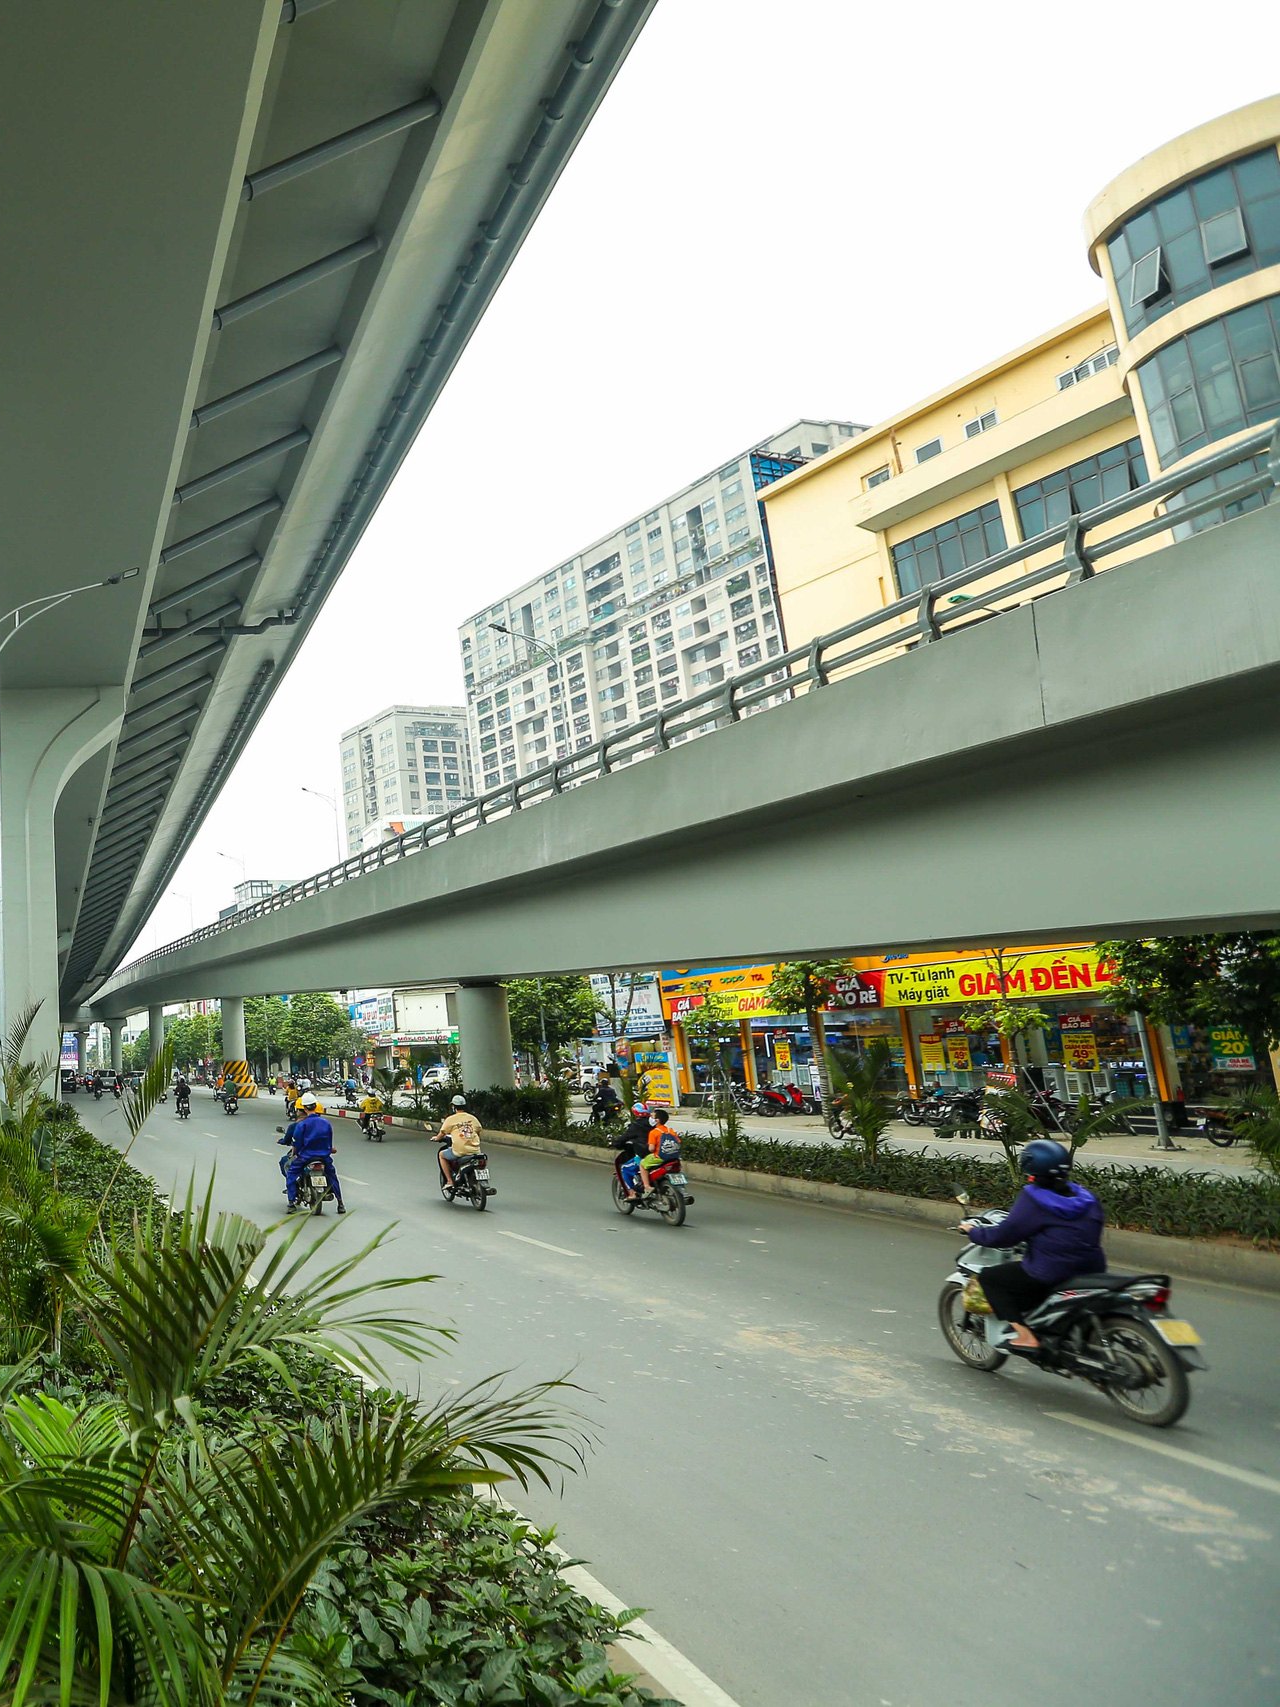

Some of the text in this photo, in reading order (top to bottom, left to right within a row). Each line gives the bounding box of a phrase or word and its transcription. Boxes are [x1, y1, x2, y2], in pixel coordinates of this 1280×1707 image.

[751, 973, 764, 981] TCL
[835, 973, 861, 992] GIÁ
[888, 972, 903, 985] TV
[928, 967, 955, 984] lạnh
[1030, 956, 1092, 992] ĐẾN
[859, 984, 878, 1004] RẺ
[898, 985, 950, 1003] Máy giặt
[677, 996, 690, 1011] GIÁ
